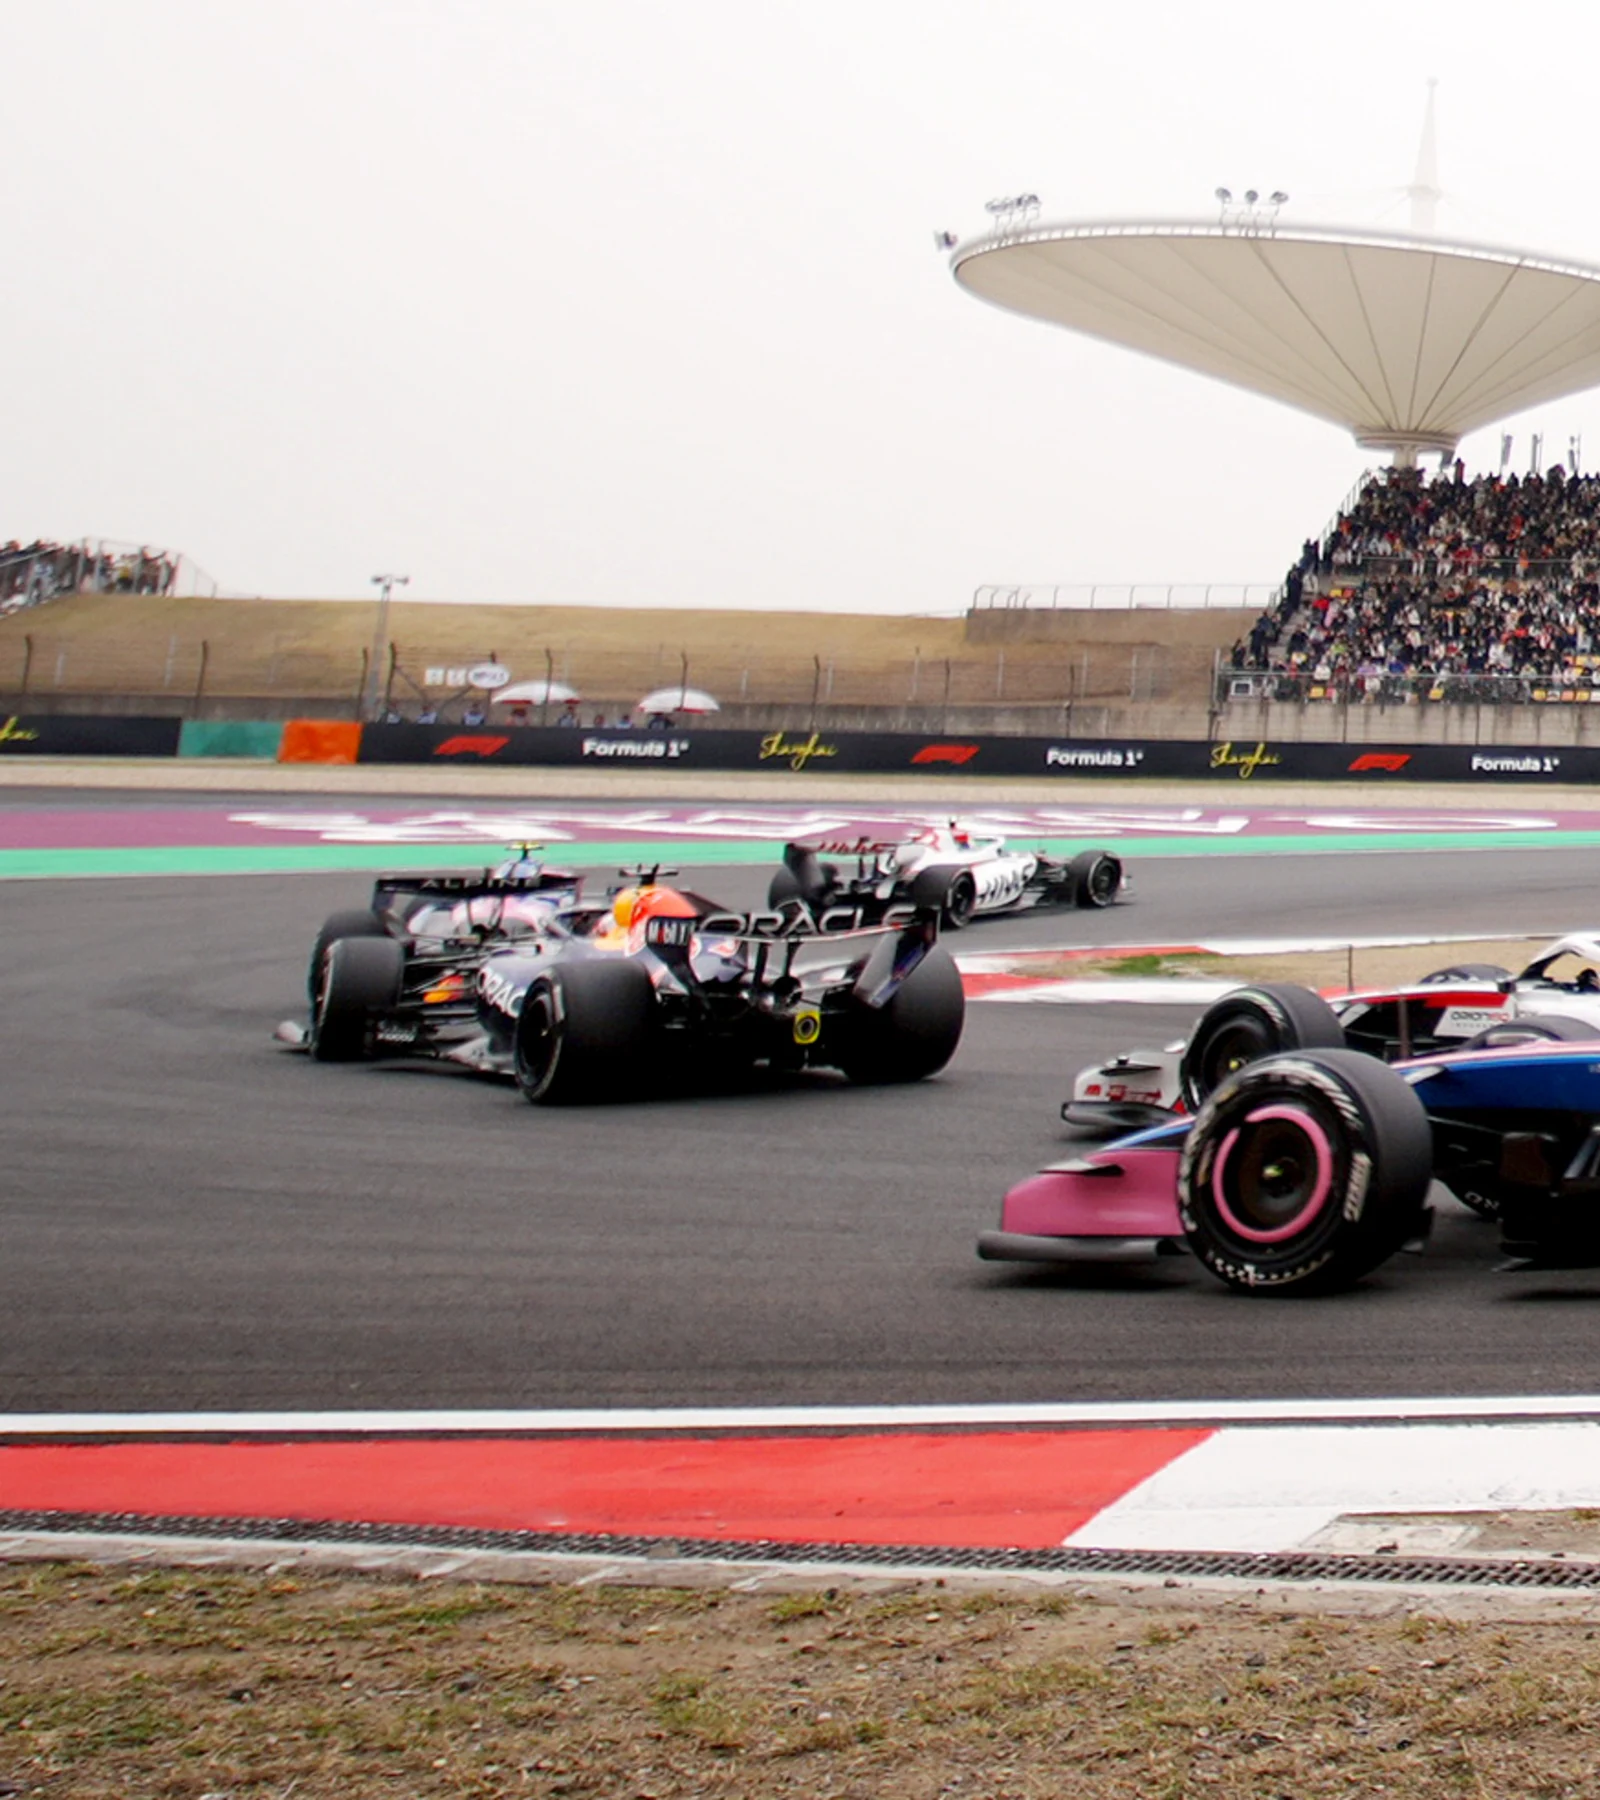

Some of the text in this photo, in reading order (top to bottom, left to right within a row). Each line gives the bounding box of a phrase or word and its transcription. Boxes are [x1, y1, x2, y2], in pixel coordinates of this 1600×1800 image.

[582, 738, 665, 758] Formula
[1047, 749, 1122, 767] Formula
[1472, 756, 1540, 773] Formula
[700, 899, 915, 938] ORACLE
